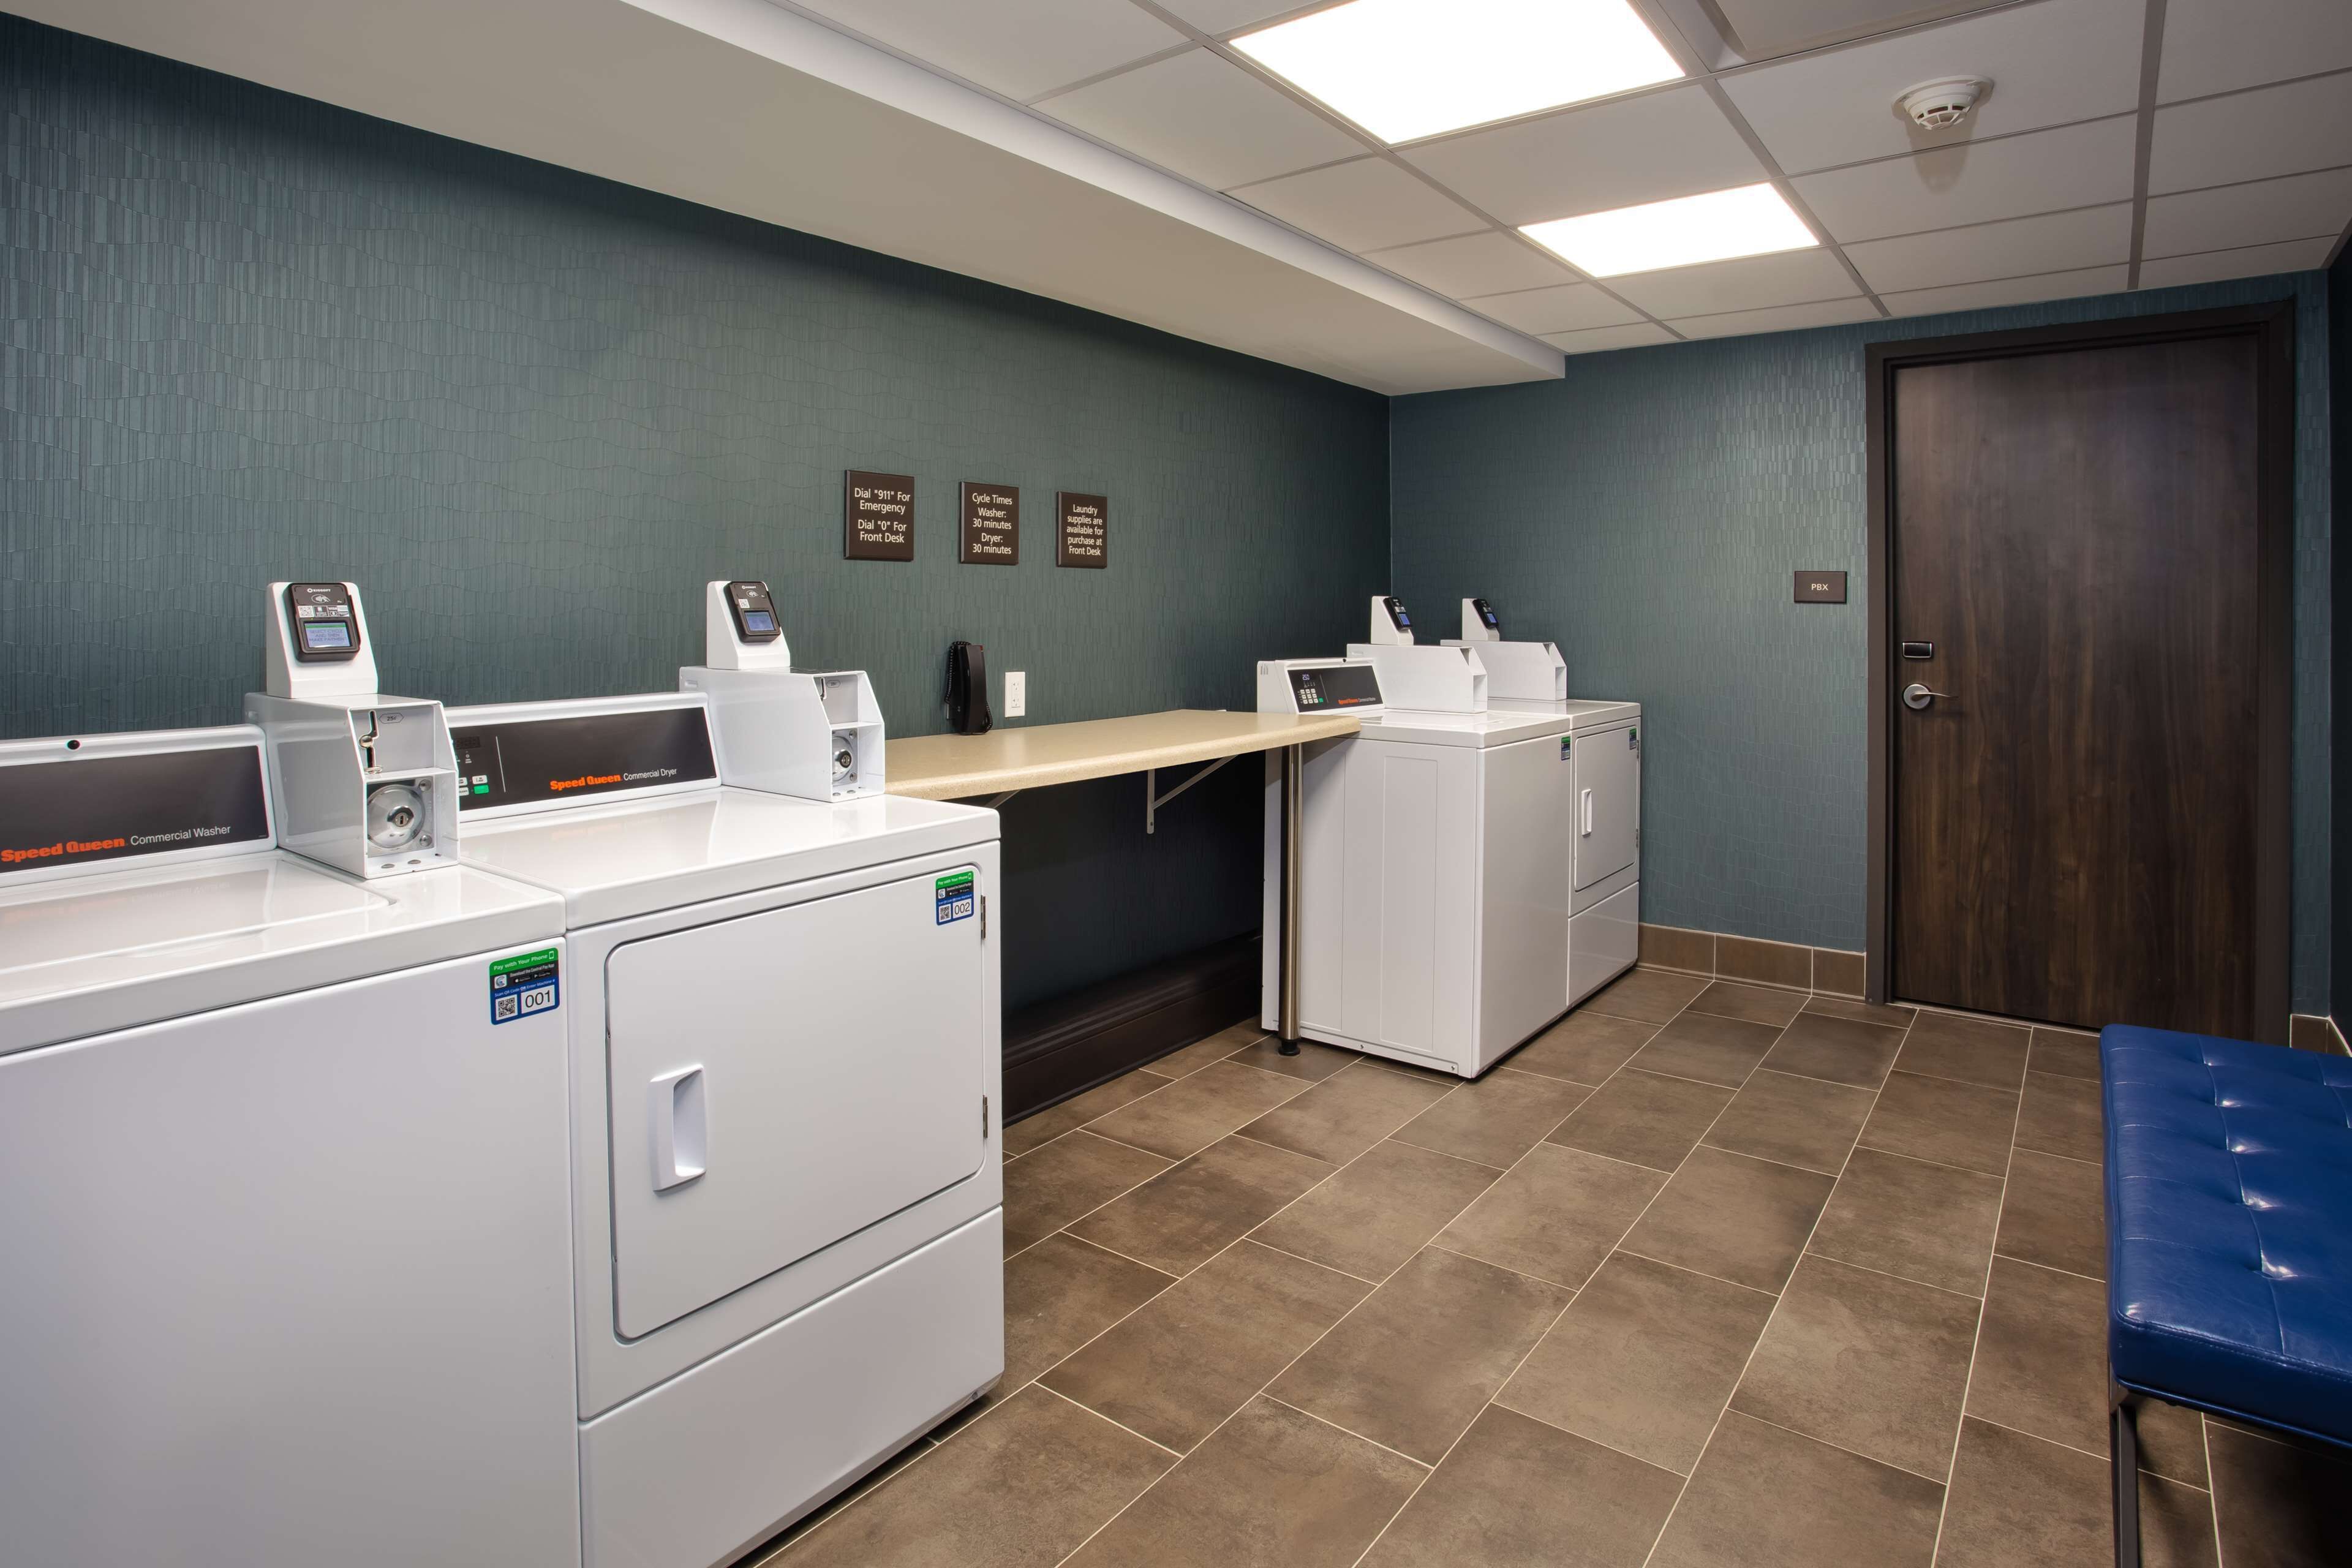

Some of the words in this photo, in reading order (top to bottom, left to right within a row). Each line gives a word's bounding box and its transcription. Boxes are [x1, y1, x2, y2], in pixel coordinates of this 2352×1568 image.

[854, 488, 870, 498] Dial
[874, 489, 894, 500] "911"
[897, 491, 910, 502] For
[972, 492, 990, 504] Cycle
[992, 494, 1012, 505] Times
[860, 500, 905, 514] Emergency
[978, 507, 1006, 518] Washer:
[1073, 504, 1098, 516] Laundry
[858, 519, 874, 529] Dial
[878, 521, 890, 530] "0"
[894, 522, 907, 532] For
[973, 518, 982, 527] 30
[984, 519, 1012, 530] minutes
[1067, 515, 1091, 525] supplies
[1066, 525, 1093, 535] available
[1094, 527, 1103, 535] for
[860, 531, 883, 541] Front
[885, 532, 904, 543] Desk
[981, 532, 1003, 544] Dryer:
[1068, 536, 1095, 545] purchase
[973, 543, 982, 552] 30
[984, 544, 1012, 554] minutes
[1069, 546, 1085, 555] Front
[1087, 547, 1101, 556] Desk
[550, 777, 586, 791] Speed
[586, 774, 621, 785] Queen
[623, 769, 660, 781] Commercial
[660, 768, 677, 778] Dryer
[1, 843, 64, 863] Speed
[66, 837, 126, 854] Queen
[130, 828, 192, 846] Commercial
[193, 825, 231, 838] Washer
[954, 902, 970, 915] 002
[525, 989, 551, 1008] 001
